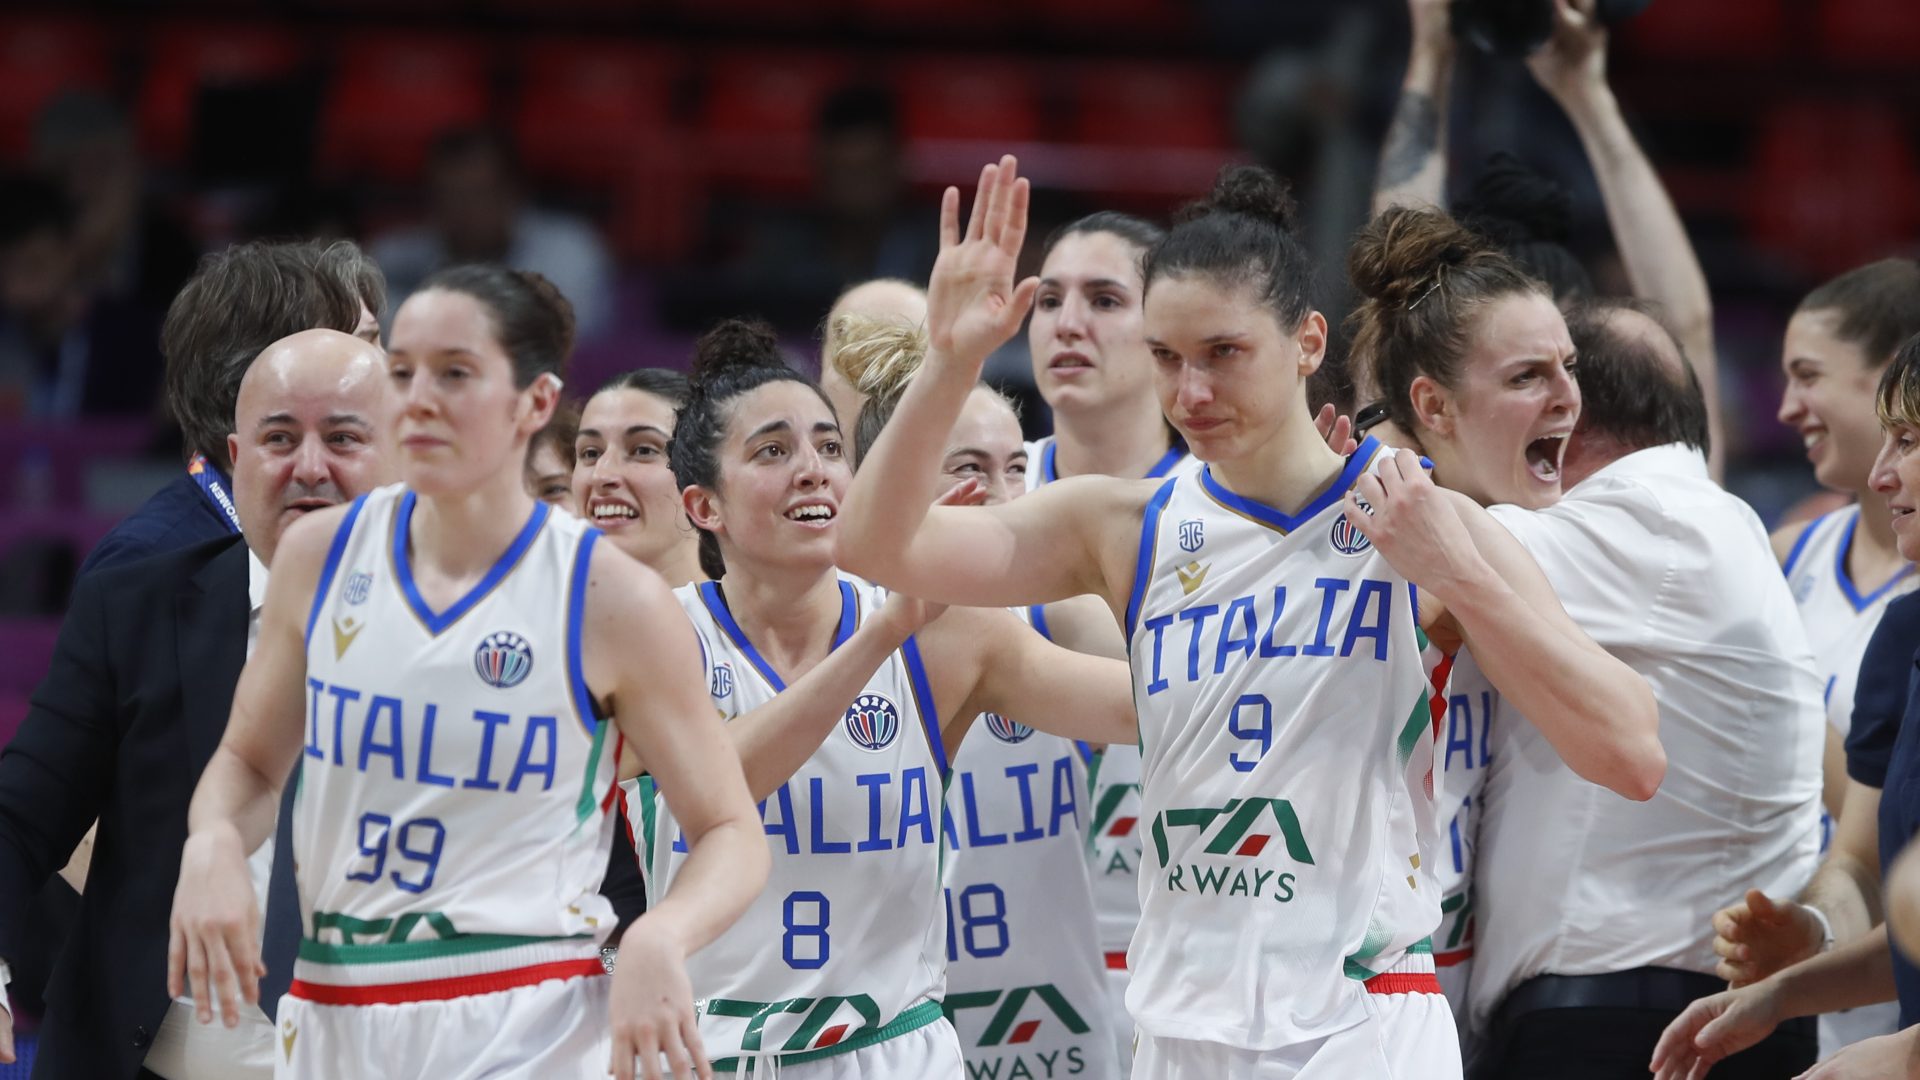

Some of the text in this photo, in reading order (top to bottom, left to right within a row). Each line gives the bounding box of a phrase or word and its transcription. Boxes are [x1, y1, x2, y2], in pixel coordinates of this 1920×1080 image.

[1144, 577, 1393, 696] ITALIA
[304, 676, 558, 792] ITALIA
[1228, 694, 1273, 773] 9
[673, 766, 935, 855] ALIA
[944, 756, 1079, 851] LIA
[346, 811, 446, 894] 99
[1168, 864, 1296, 903] RWAYS
[782, 891, 830, 970] 8
[965, 1047, 1085, 1080] WAYS
